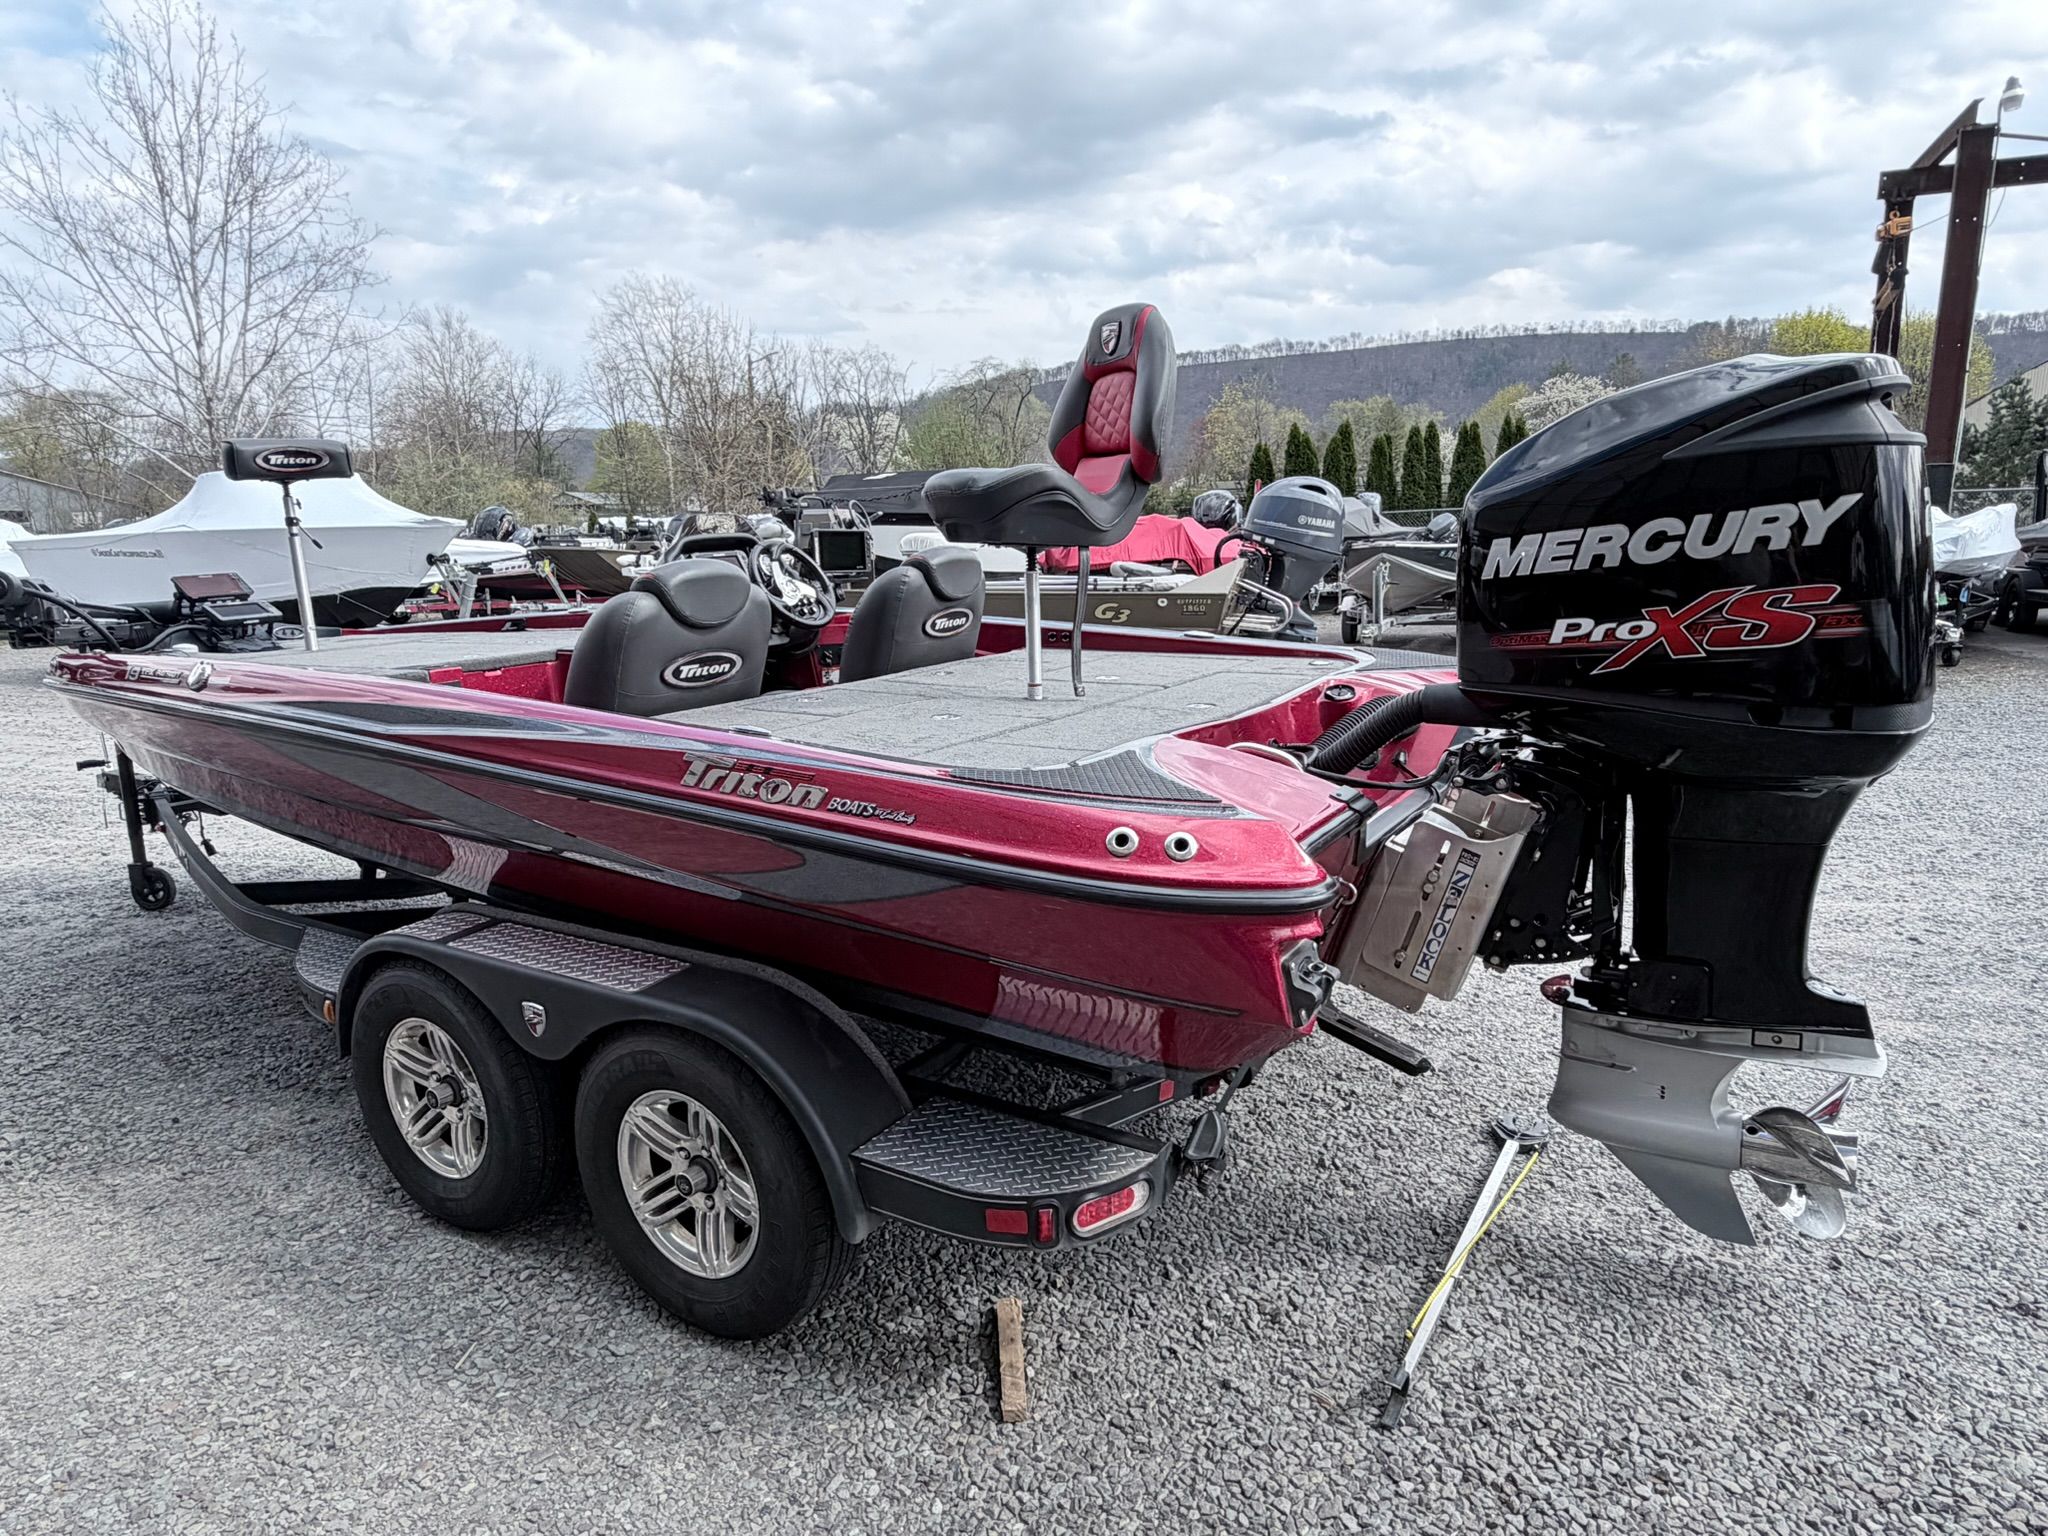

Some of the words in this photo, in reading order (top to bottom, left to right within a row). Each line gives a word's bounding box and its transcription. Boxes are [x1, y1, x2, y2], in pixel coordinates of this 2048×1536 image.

[268, 455, 317, 465] Triton
[1307, 516, 1336, 529] YAMAHA
[1481, 492, 1864, 580] MERCURY
[1095, 602, 1131, 623] G3
[935, 617, 967, 630] Triton
[680, 663, 731, 679] Triton
[680, 751, 829, 809] Triton
[827, 797, 877, 817] BOATS
